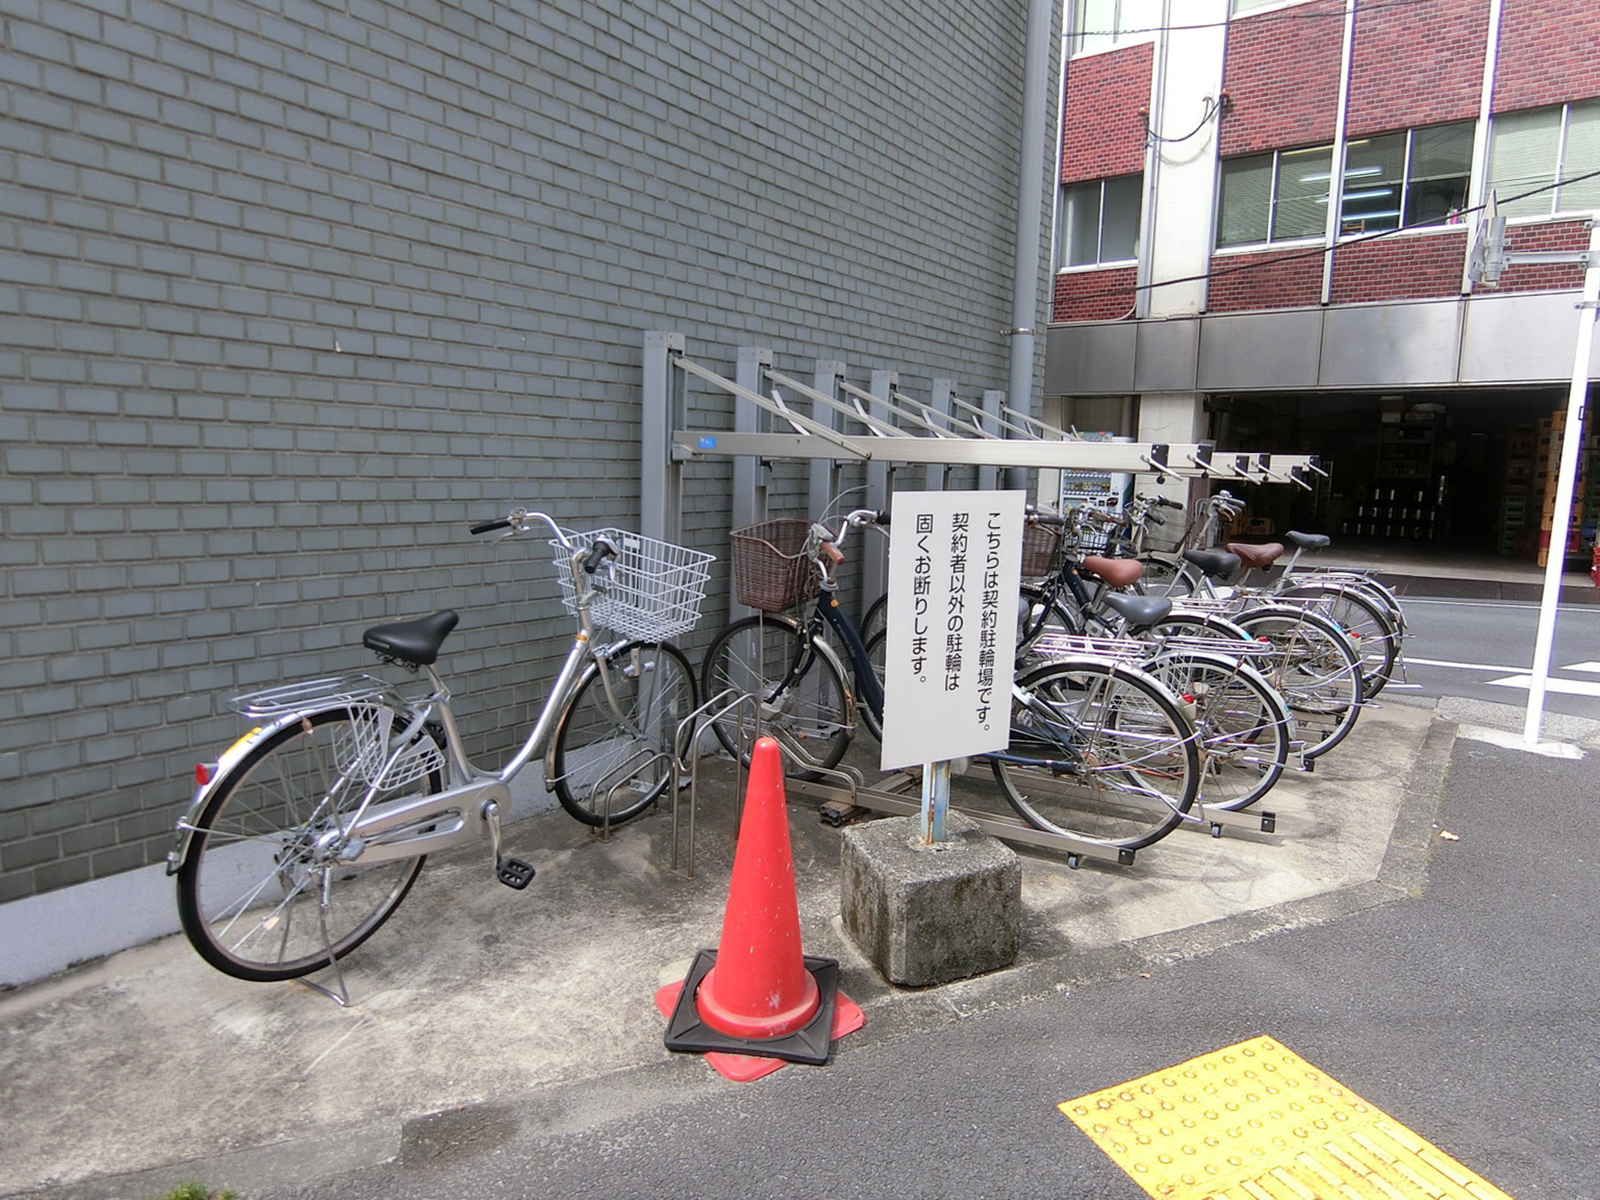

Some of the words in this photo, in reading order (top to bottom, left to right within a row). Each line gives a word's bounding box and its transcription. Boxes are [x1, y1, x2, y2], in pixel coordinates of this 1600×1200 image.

[911, 513, 934, 683] 固くお断りします。
[944, 512, 969, 692] 契約者以外の駐輪は
[976, 512, 1001, 731] こちらは契約駐輪場です。
